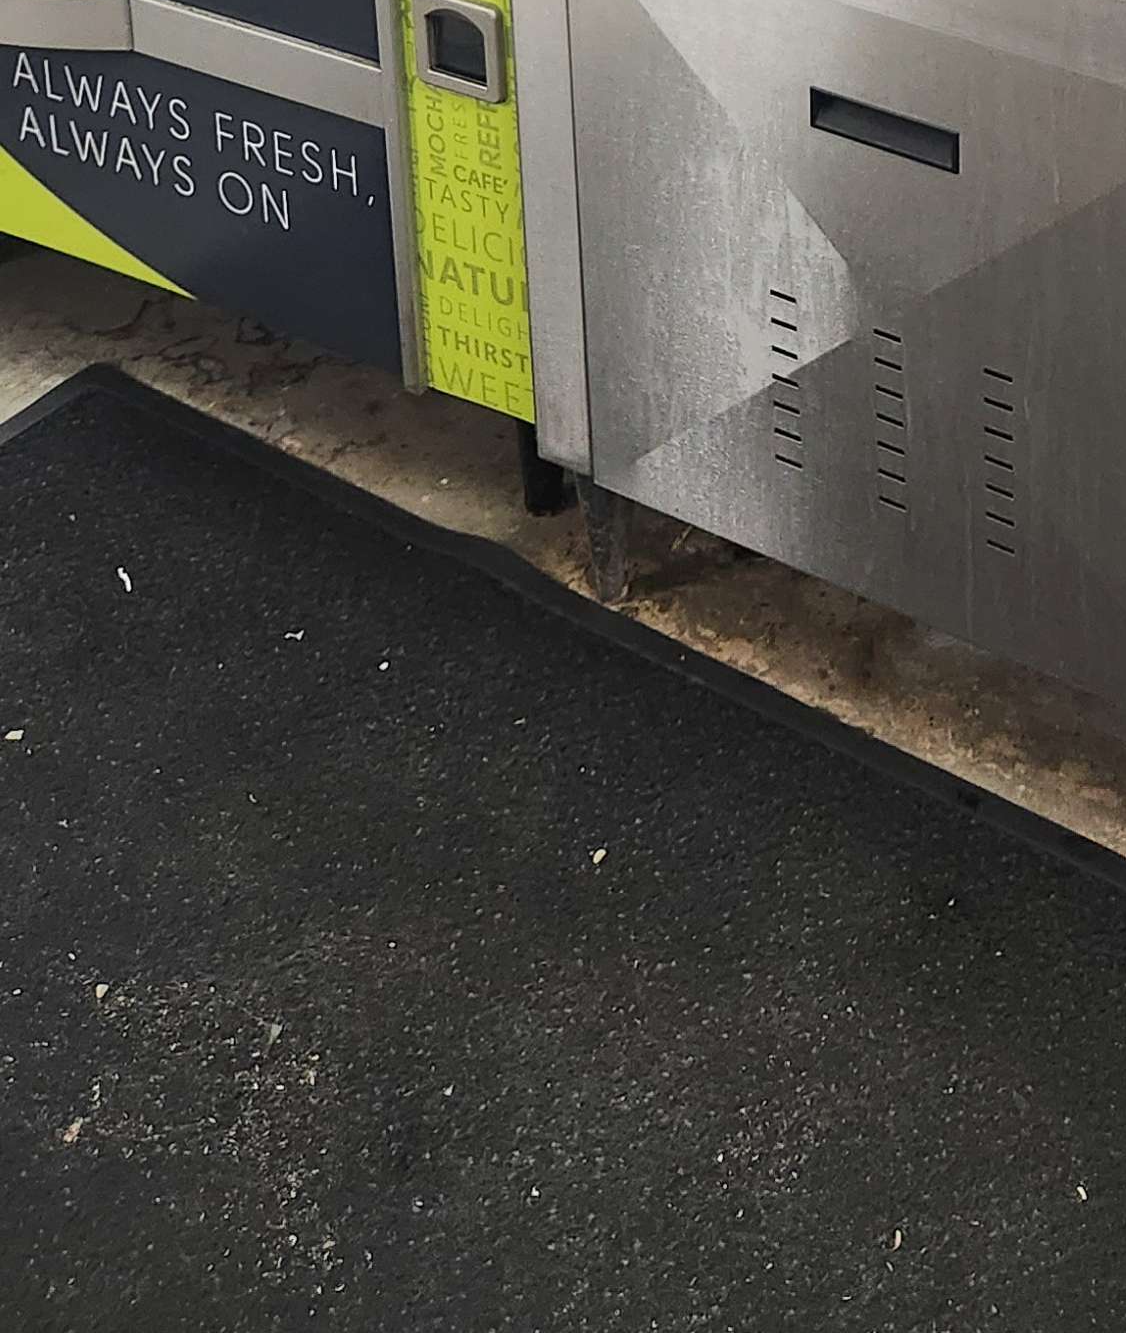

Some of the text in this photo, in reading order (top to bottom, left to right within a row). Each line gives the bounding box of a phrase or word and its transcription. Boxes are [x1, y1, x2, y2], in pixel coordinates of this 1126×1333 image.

[13, 51, 375, 208] ALWAYS FRESH,
[20, 106, 291, 231] ALWAYS ON
[423, 177, 509, 224] TASTY
[415, 207, 525, 267] DELICI
[437, 325, 529, 373] THIRST
[438, 356, 534, 415] WEE
